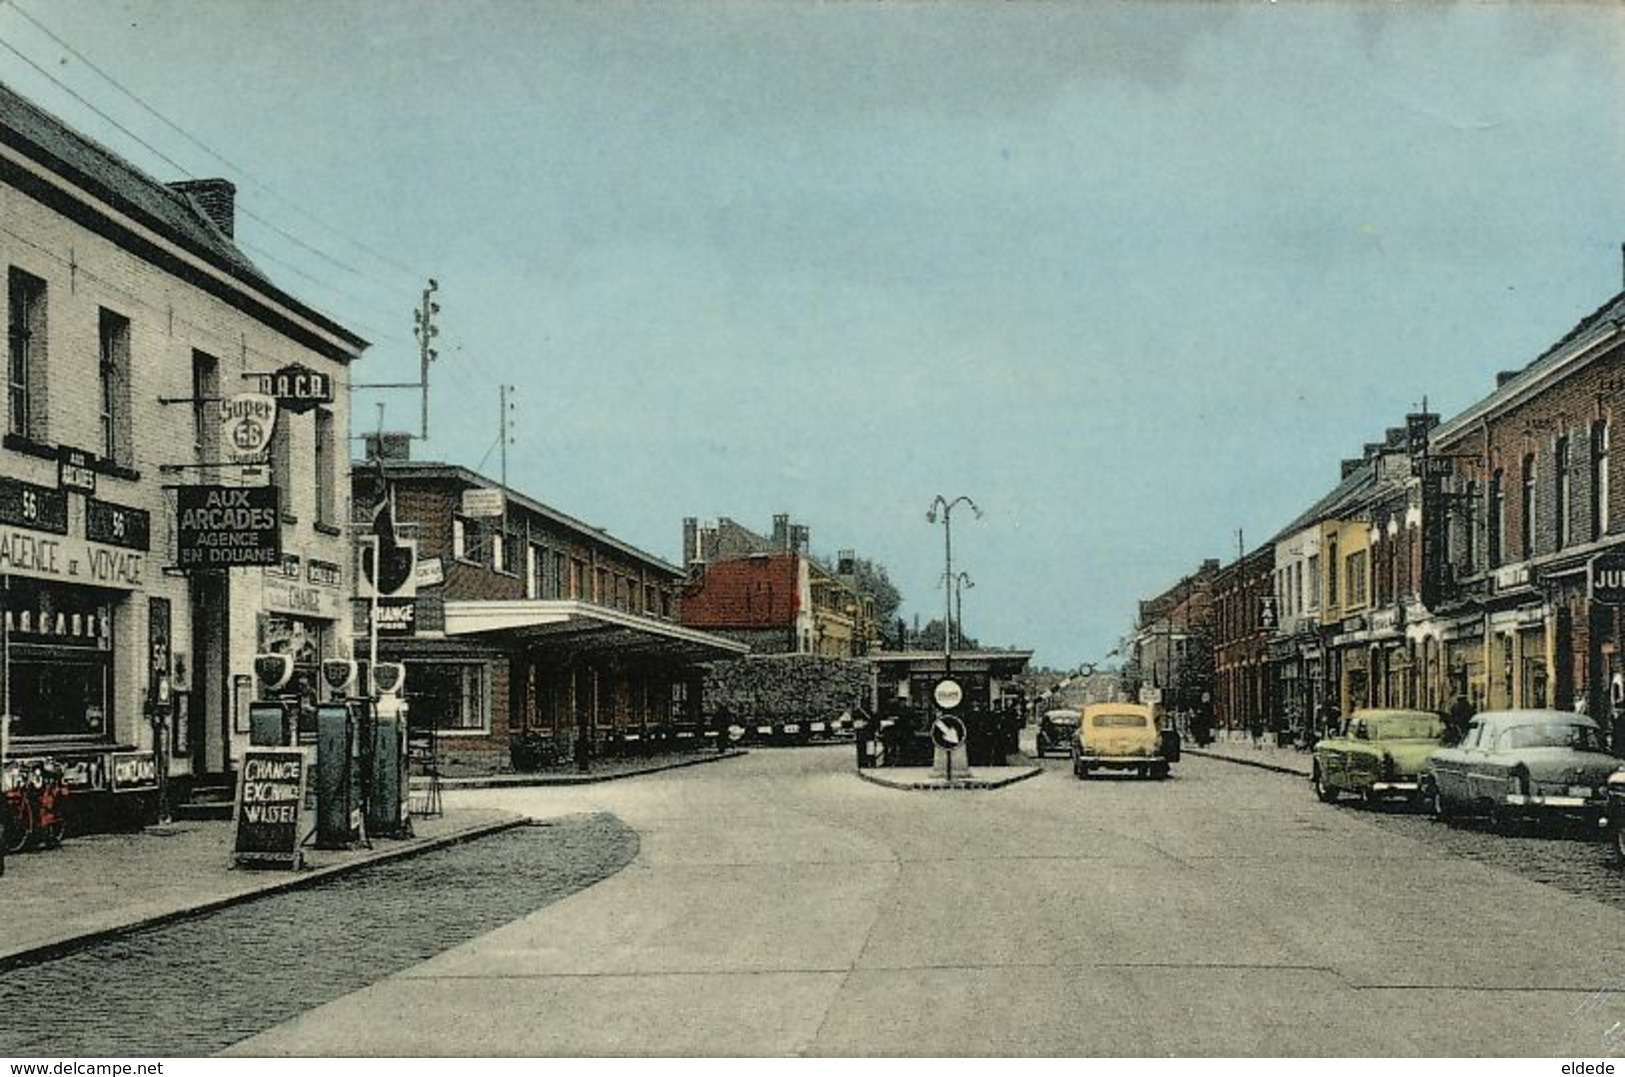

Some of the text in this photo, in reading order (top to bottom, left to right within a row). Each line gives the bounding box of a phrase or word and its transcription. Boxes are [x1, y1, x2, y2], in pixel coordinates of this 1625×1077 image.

[219, 399, 273, 423] Super
[23, 490, 37, 519] 56
[205, 490, 250, 508] AUX
[112, 511, 125, 538] 56
[180, 508, 275, 530] ARCADES
[196, 532, 259, 547] AGENCE
[1, 532, 60, 575] AGENCE
[182, 548, 275, 562] EN DOUANE
[328, 665, 348, 680] BP
[244, 759, 300, 781] CHANGE
